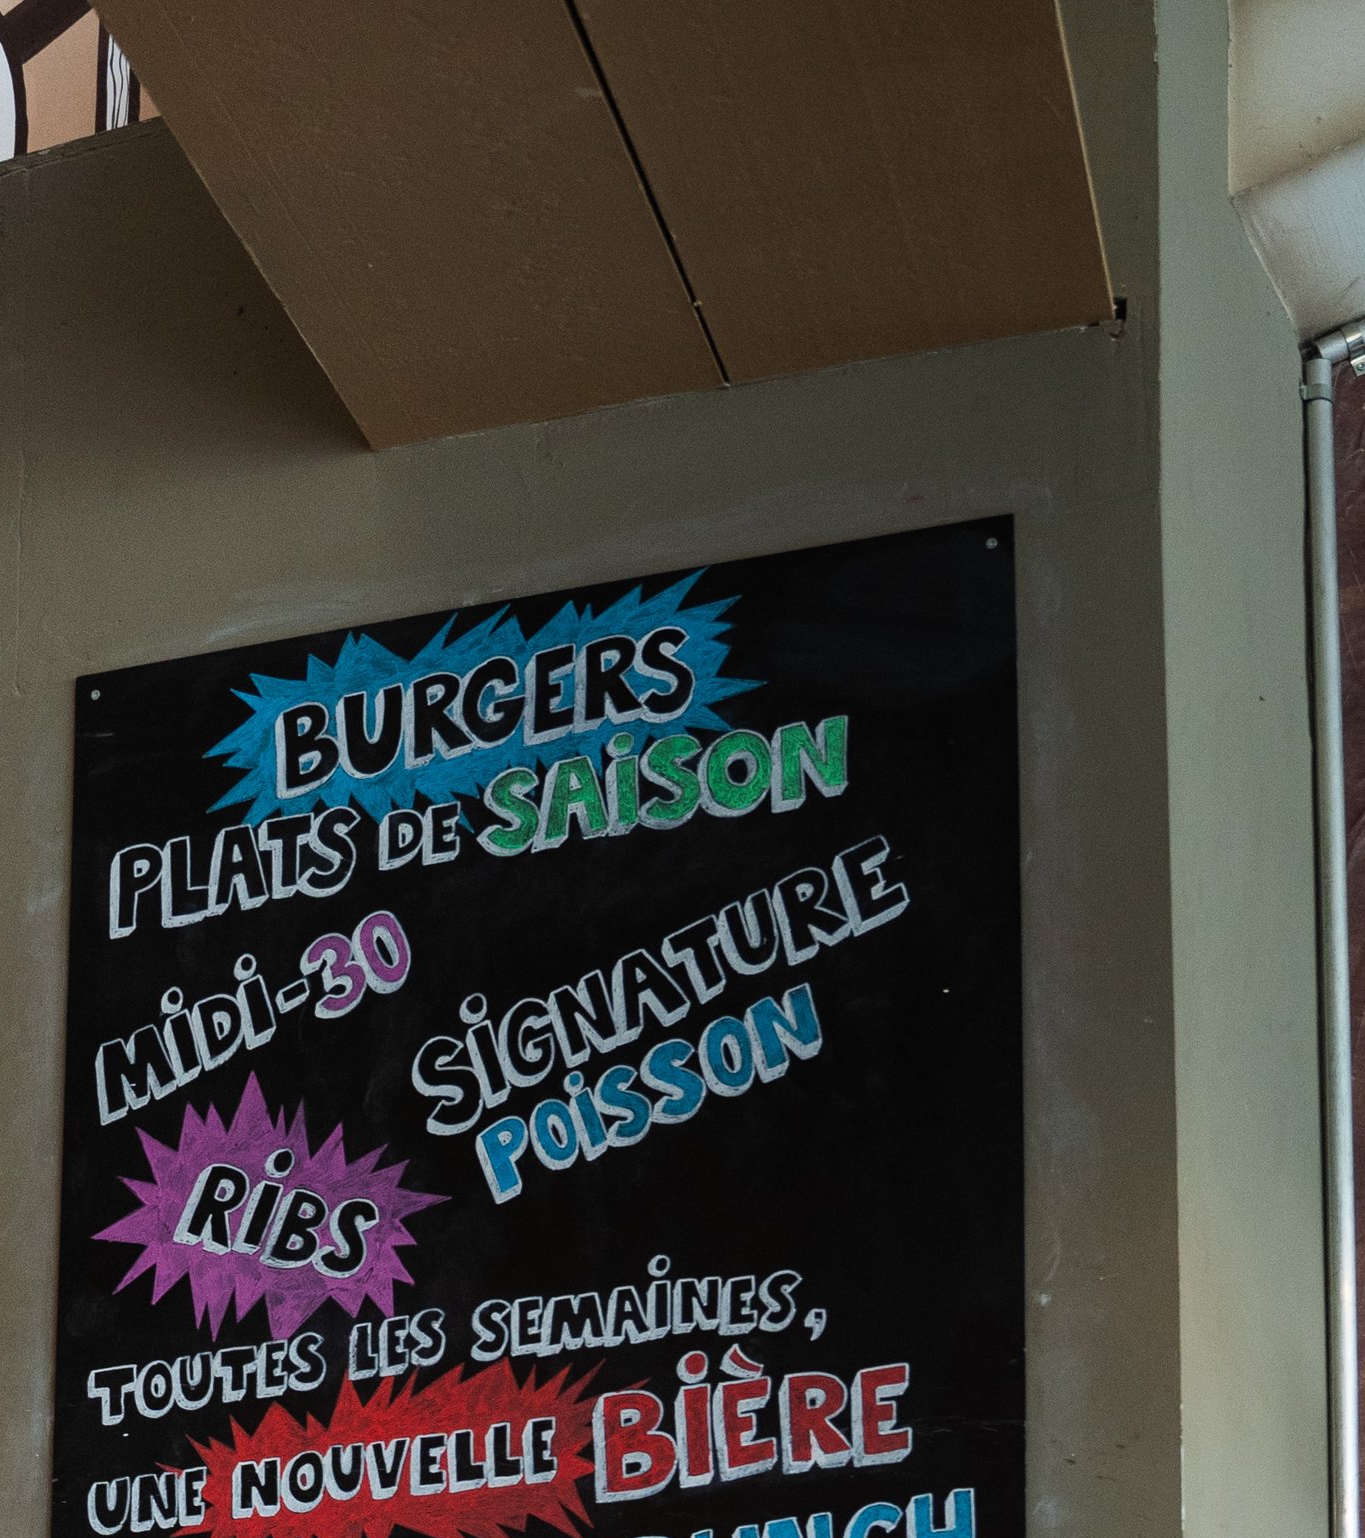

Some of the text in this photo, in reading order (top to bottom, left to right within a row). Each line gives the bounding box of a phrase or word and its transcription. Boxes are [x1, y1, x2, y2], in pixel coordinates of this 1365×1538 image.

[274, 624, 697, 799] BURGERS
[109, 807, 359, 938] PLATS
[377, 802, 460, 871] DE
[88, 1331, 327, 1425] TOUTES
[348, 1308, 446, 1381] LES
[88, 1466, 207, 1537] UNE
[232, 1417, 560, 1522] NOUVELLE
